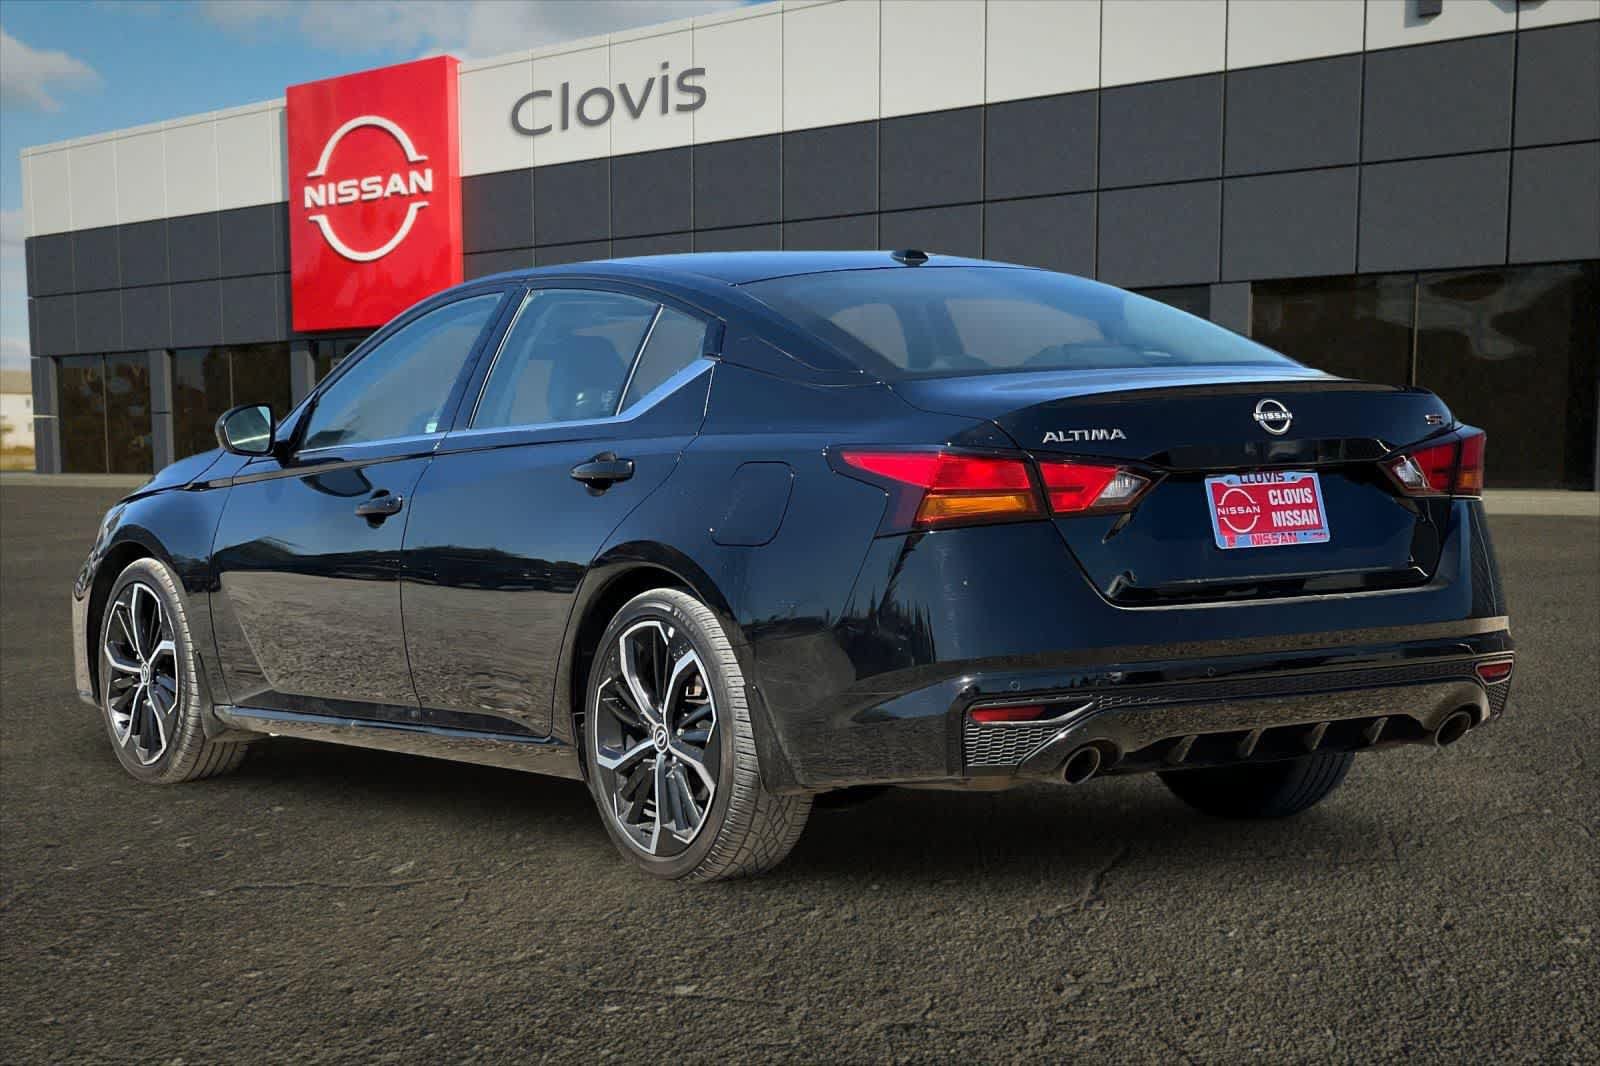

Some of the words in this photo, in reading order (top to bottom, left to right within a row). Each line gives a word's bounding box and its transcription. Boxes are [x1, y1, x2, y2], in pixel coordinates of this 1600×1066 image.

[511, 62, 707, 136] Clovis
[304, 168, 433, 208] NISSAN
[1253, 411, 1293, 422] NISSAN
[1042, 428, 1127, 443] ALTIMA
[1268, 488, 1313, 506] CLOVIS
[1217, 505, 1261, 516] NISSAN
[1271, 509, 1319, 527] NISSAN
[1251, 532, 1297, 545] NISSAN
